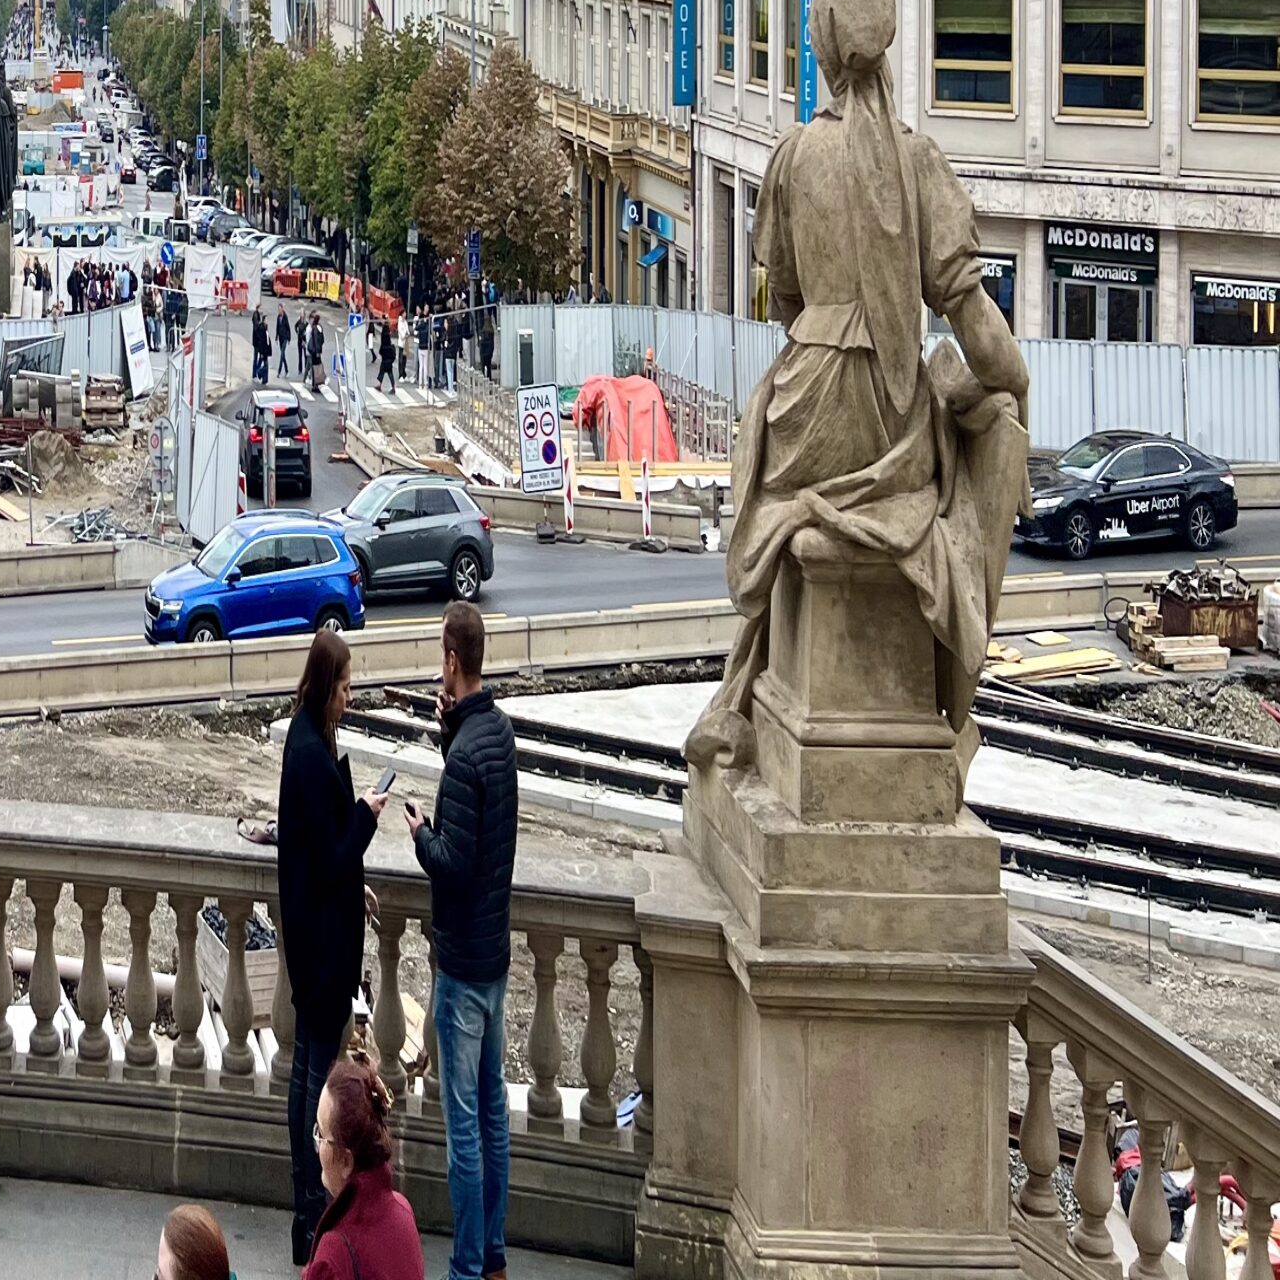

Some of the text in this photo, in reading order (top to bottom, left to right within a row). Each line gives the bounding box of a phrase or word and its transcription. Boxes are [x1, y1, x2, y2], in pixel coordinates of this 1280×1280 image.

[1048, 227, 1155, 253] McDonald's
[1072, 263, 1138, 282] McDonald's
[1206, 282, 1277, 302] McDonald's
[524, 393, 551, 411] ZÓNA
[1126, 494, 1180, 515] Uber Airport
